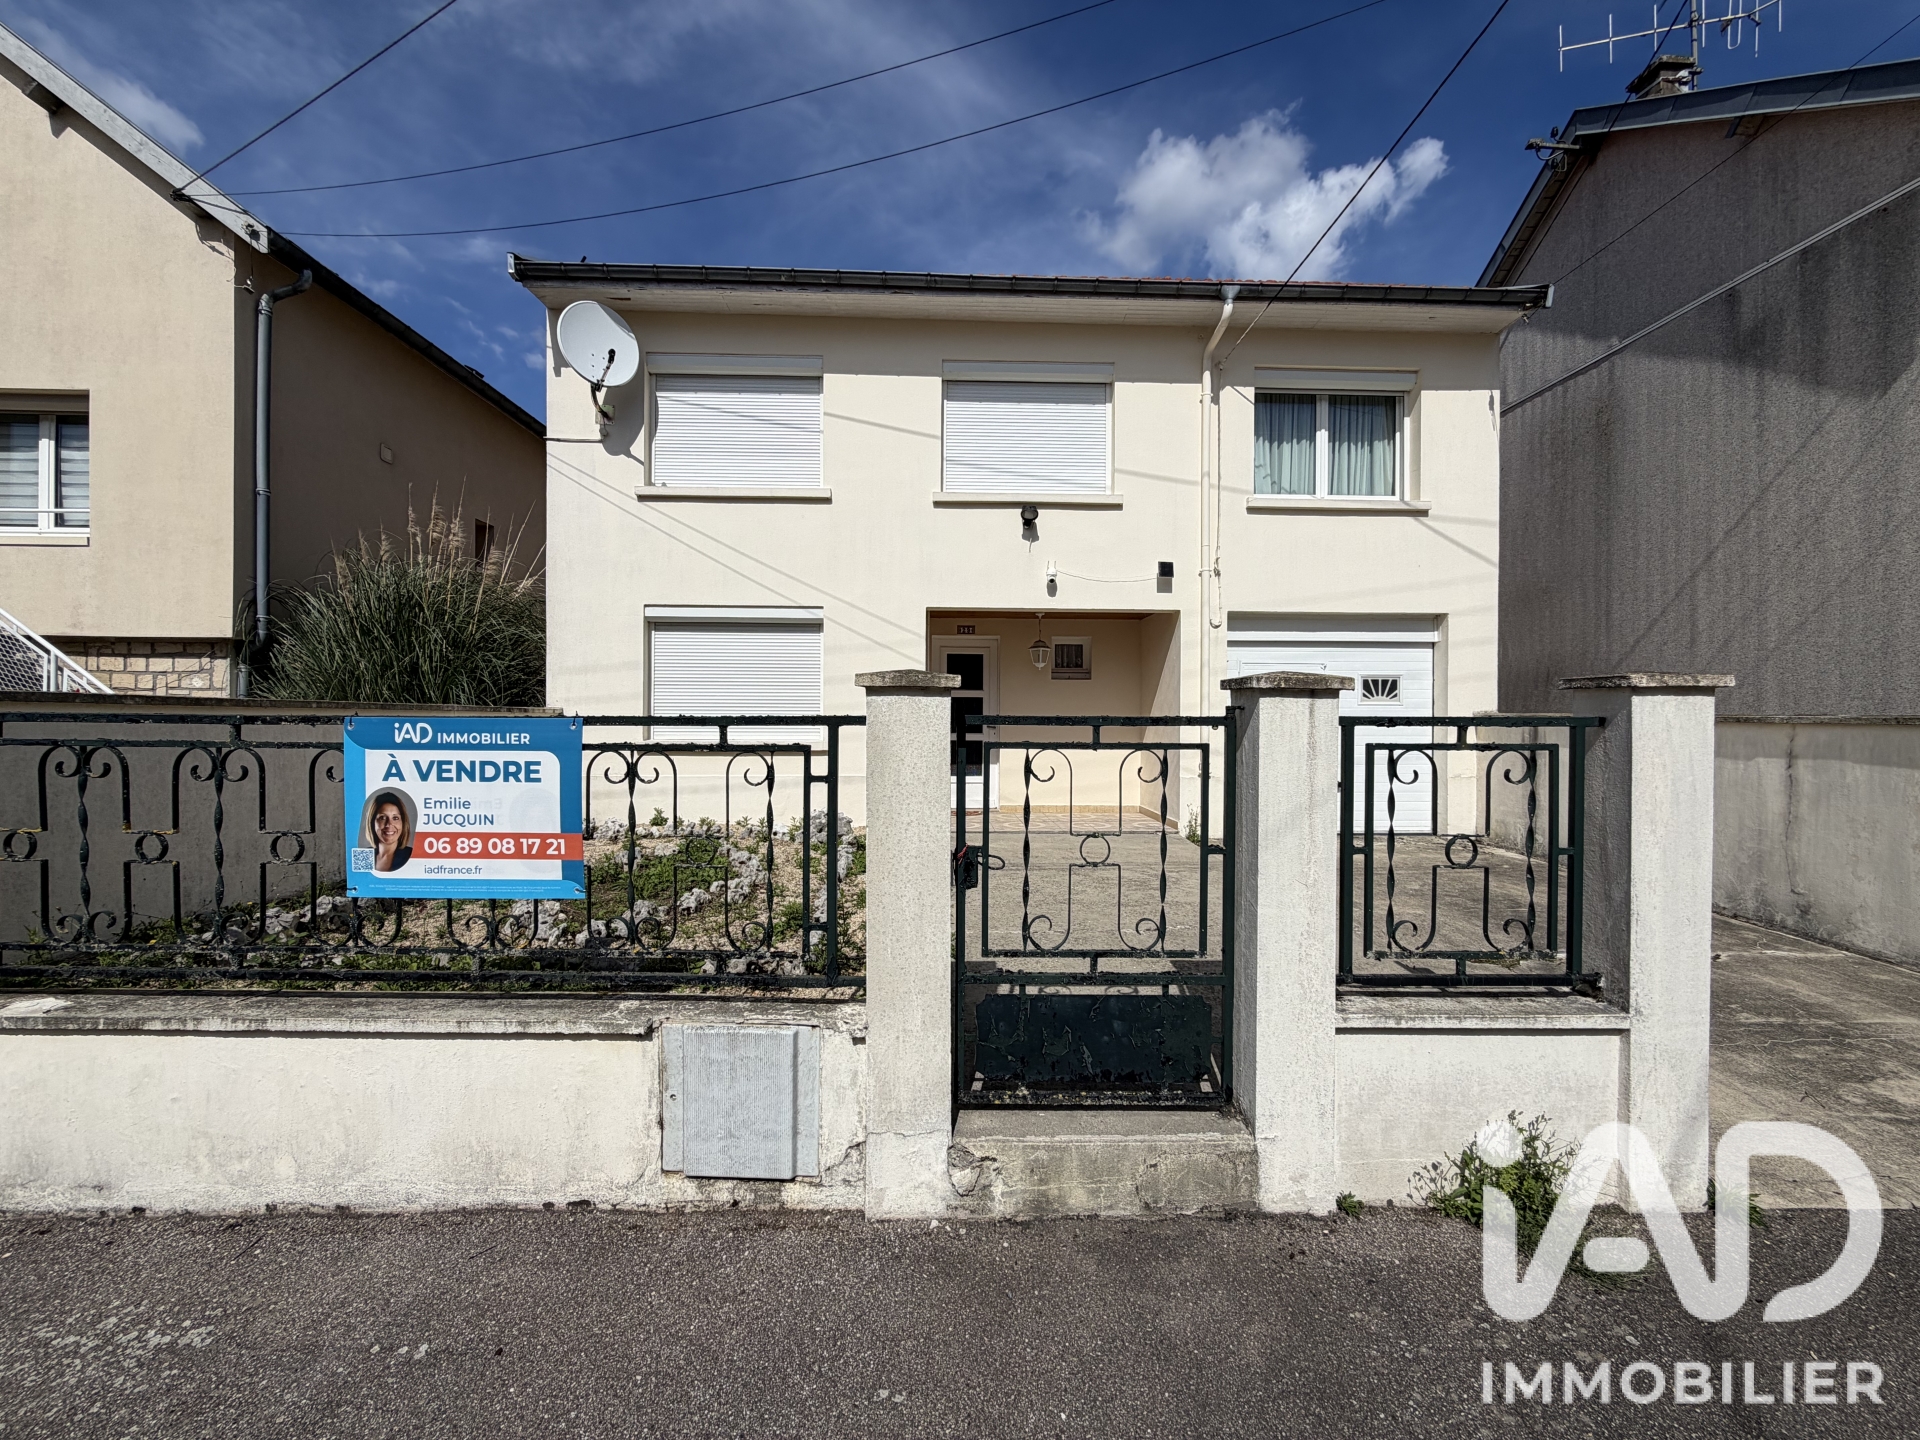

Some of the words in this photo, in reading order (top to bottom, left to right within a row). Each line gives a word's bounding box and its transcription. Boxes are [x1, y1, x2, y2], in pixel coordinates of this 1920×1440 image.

[437, 733, 531, 745] IMMOBILIER
[382, 753, 406, 782] À
[412, 760, 542, 783] VENDRE
[423, 797, 471, 810] Emilie
[423, 813, 494, 828] JUCQUIN
[423, 837, 451, 855] 06
[456, 837, 482, 855] 89
[488, 837, 515, 855] 08
[520, 838, 543, 855] 17
[546, 838, 566, 855] 21
[424, 864, 482, 875] iadfrance.fr
